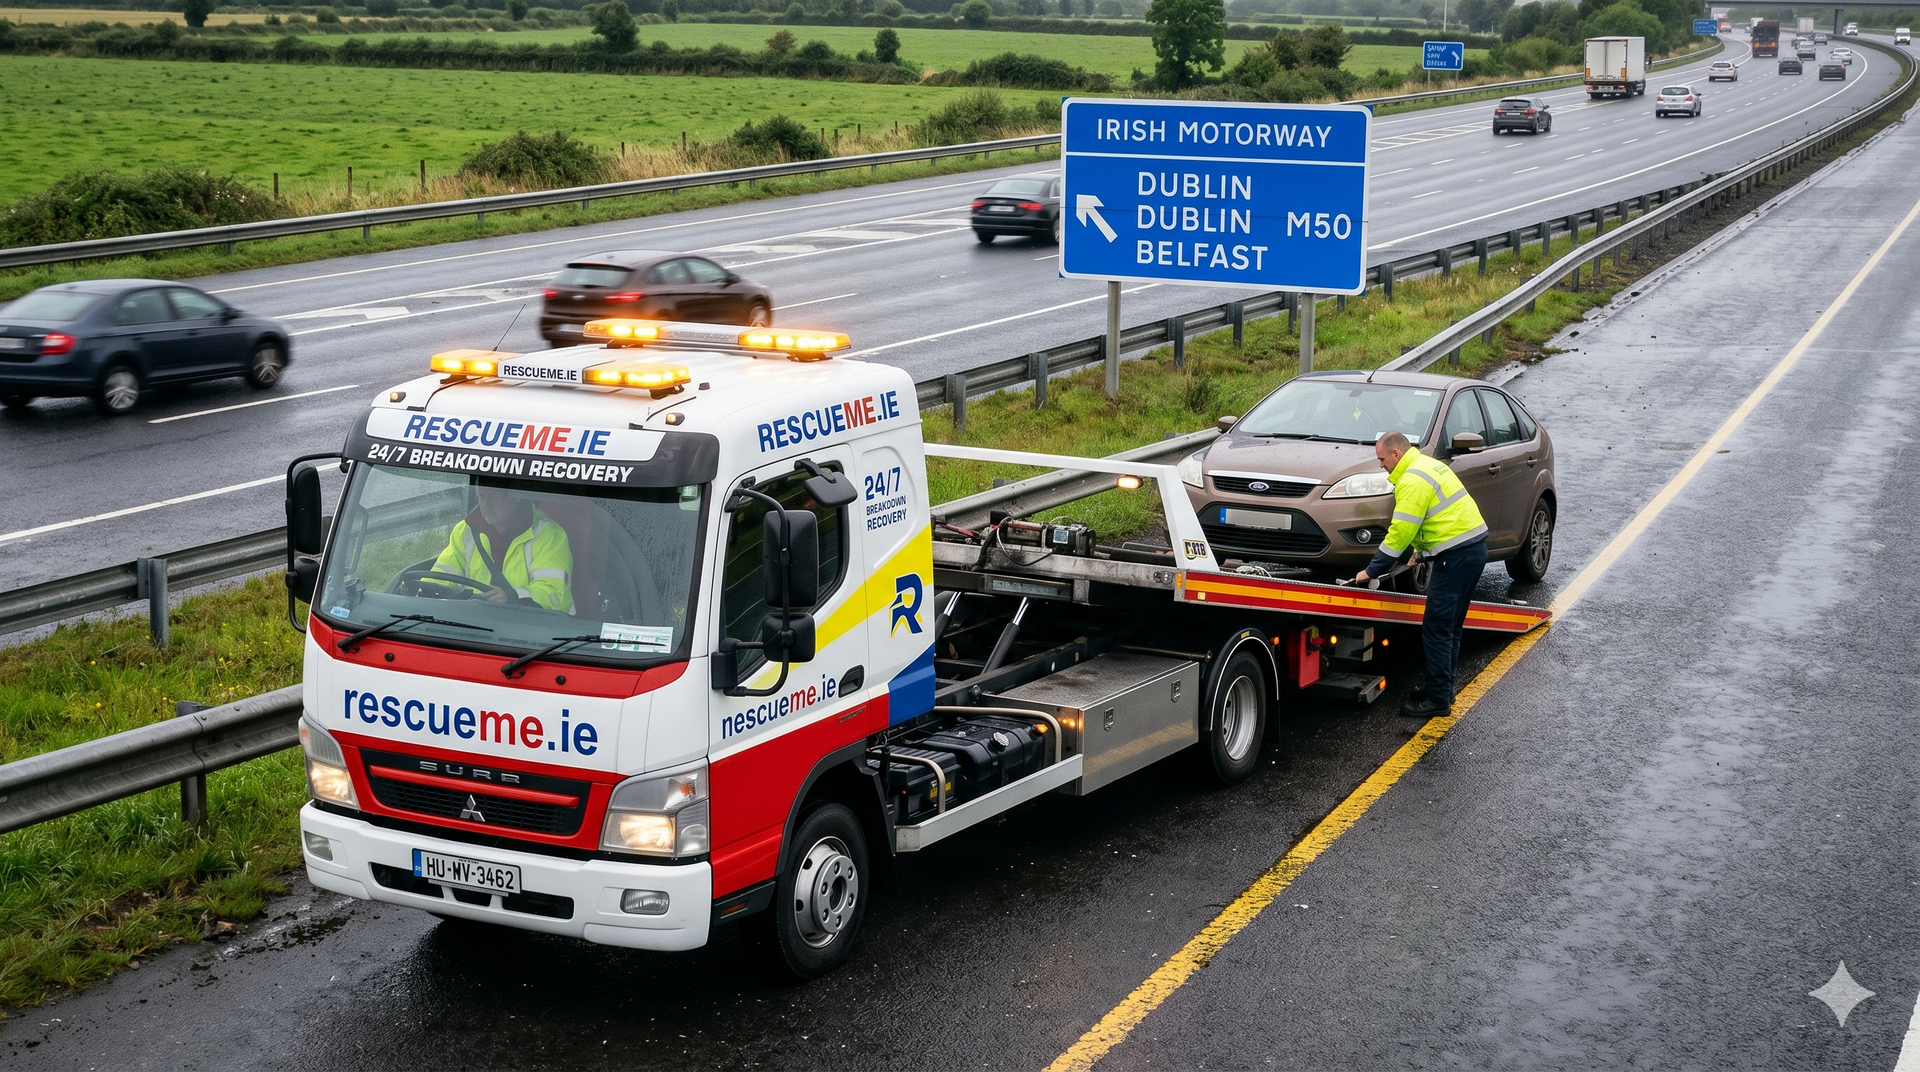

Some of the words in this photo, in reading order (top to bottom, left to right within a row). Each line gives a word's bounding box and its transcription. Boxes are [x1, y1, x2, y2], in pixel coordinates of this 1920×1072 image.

[1097, 118, 1166, 142] IRISH
[1179, 121, 1332, 148] MOTORWAY
[1138, 171, 1252, 200] DUBLIN
[1137, 204, 1251, 234] DUBLIN
[1286, 211, 1352, 240] M50
[1136, 240, 1268, 270] BELFAST
[503, 365, 578, 381] RESCUEME.IE
[403, 414, 611, 456] RESCUEME.IE
[757, 390, 900, 452] RESCUEME.IE
[367, 443, 407, 463] 24/7
[408, 449, 527, 475] BREAKDOWN
[528, 461, 634, 483] RECOVERY
[864, 466, 901, 501] 24/7
[866, 495, 907, 516] BREAKDOWN
[867, 508, 907, 532] RECOVERY
[343, 688, 599, 756] rescueme.ie
